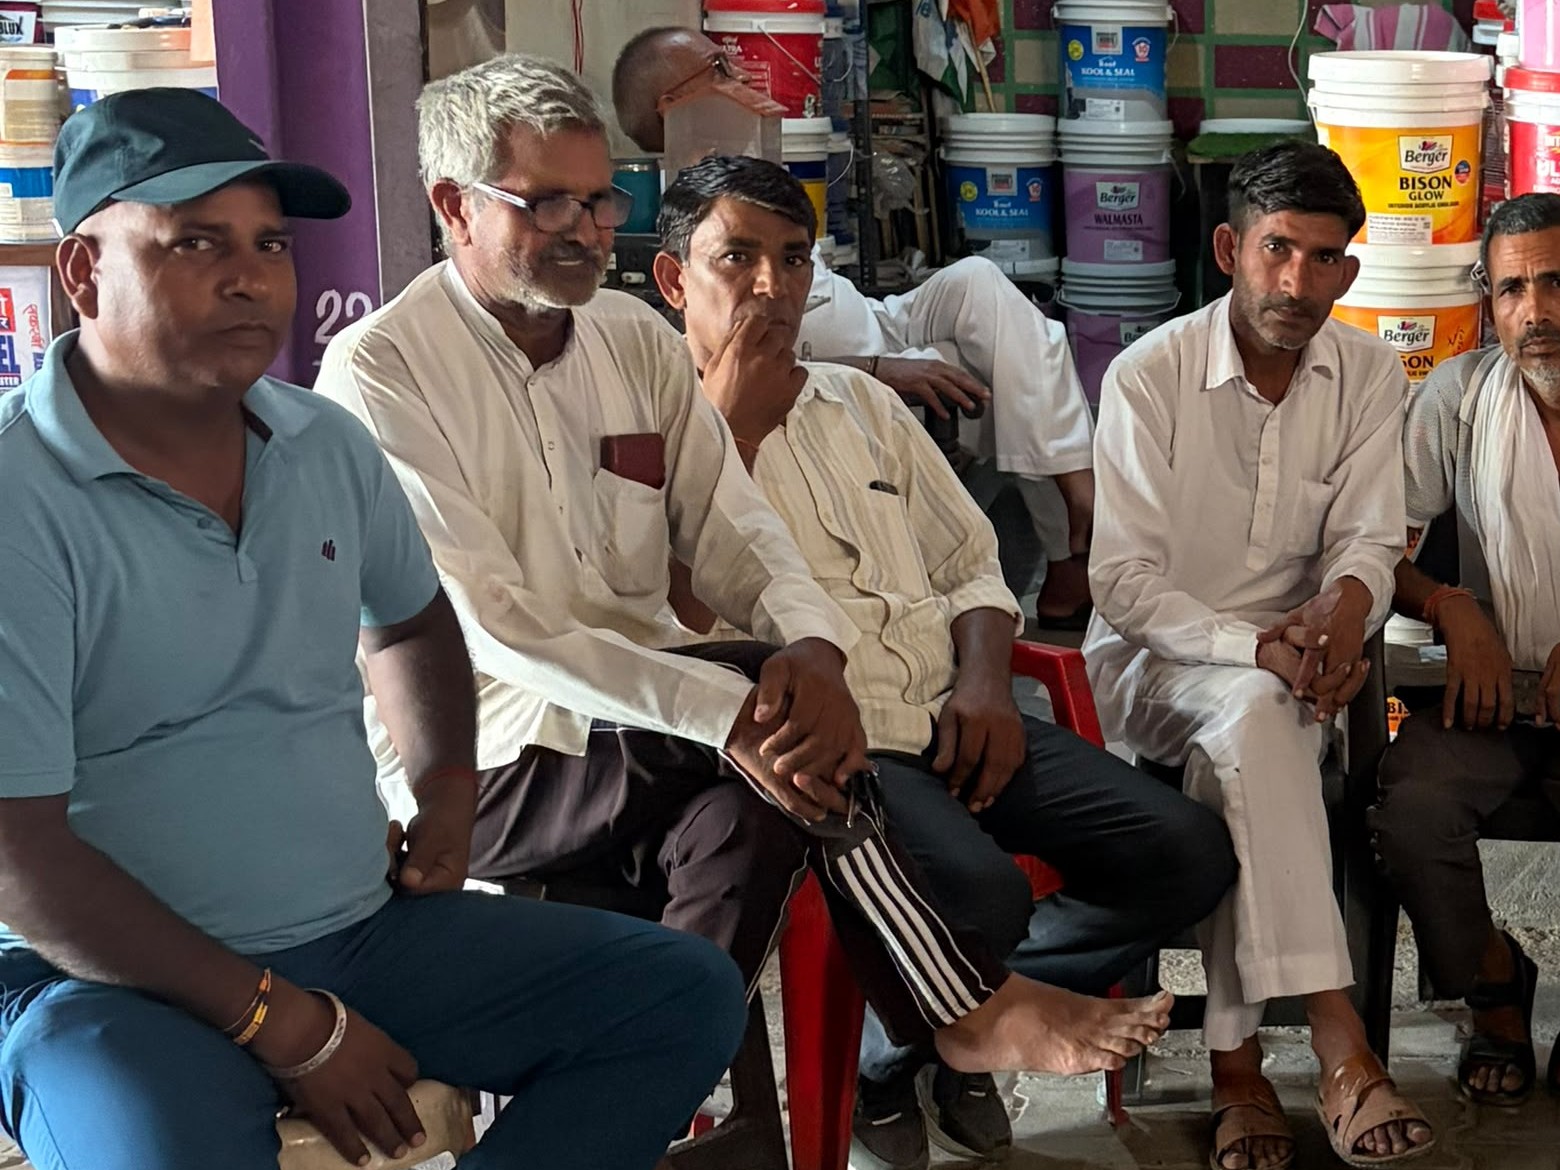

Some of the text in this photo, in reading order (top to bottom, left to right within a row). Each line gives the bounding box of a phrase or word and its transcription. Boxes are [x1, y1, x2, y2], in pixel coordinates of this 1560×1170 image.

[1405, 150, 1449, 166] Berger
[1399, 176, 1452, 190] BISON
[1100, 192, 1136, 205] Berger
[1408, 191, 1444, 201] GLOW
[1094, 213, 1143, 225] WALMASTA
[1384, 329, 1430, 346] Berger
